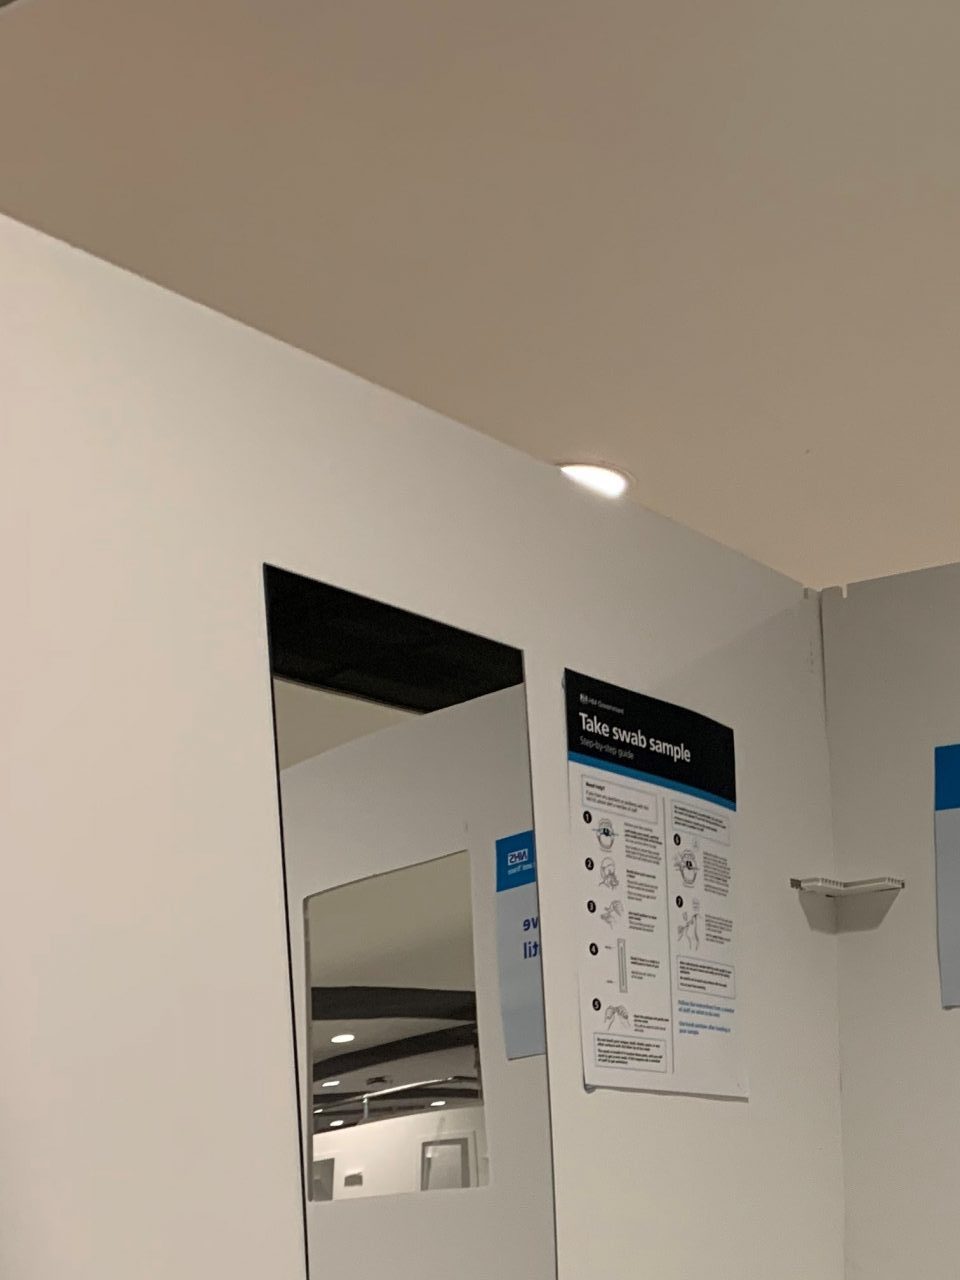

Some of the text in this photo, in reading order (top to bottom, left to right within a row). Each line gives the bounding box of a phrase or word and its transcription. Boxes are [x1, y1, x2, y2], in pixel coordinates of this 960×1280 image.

[579, 712, 691, 763] Take swab sample
